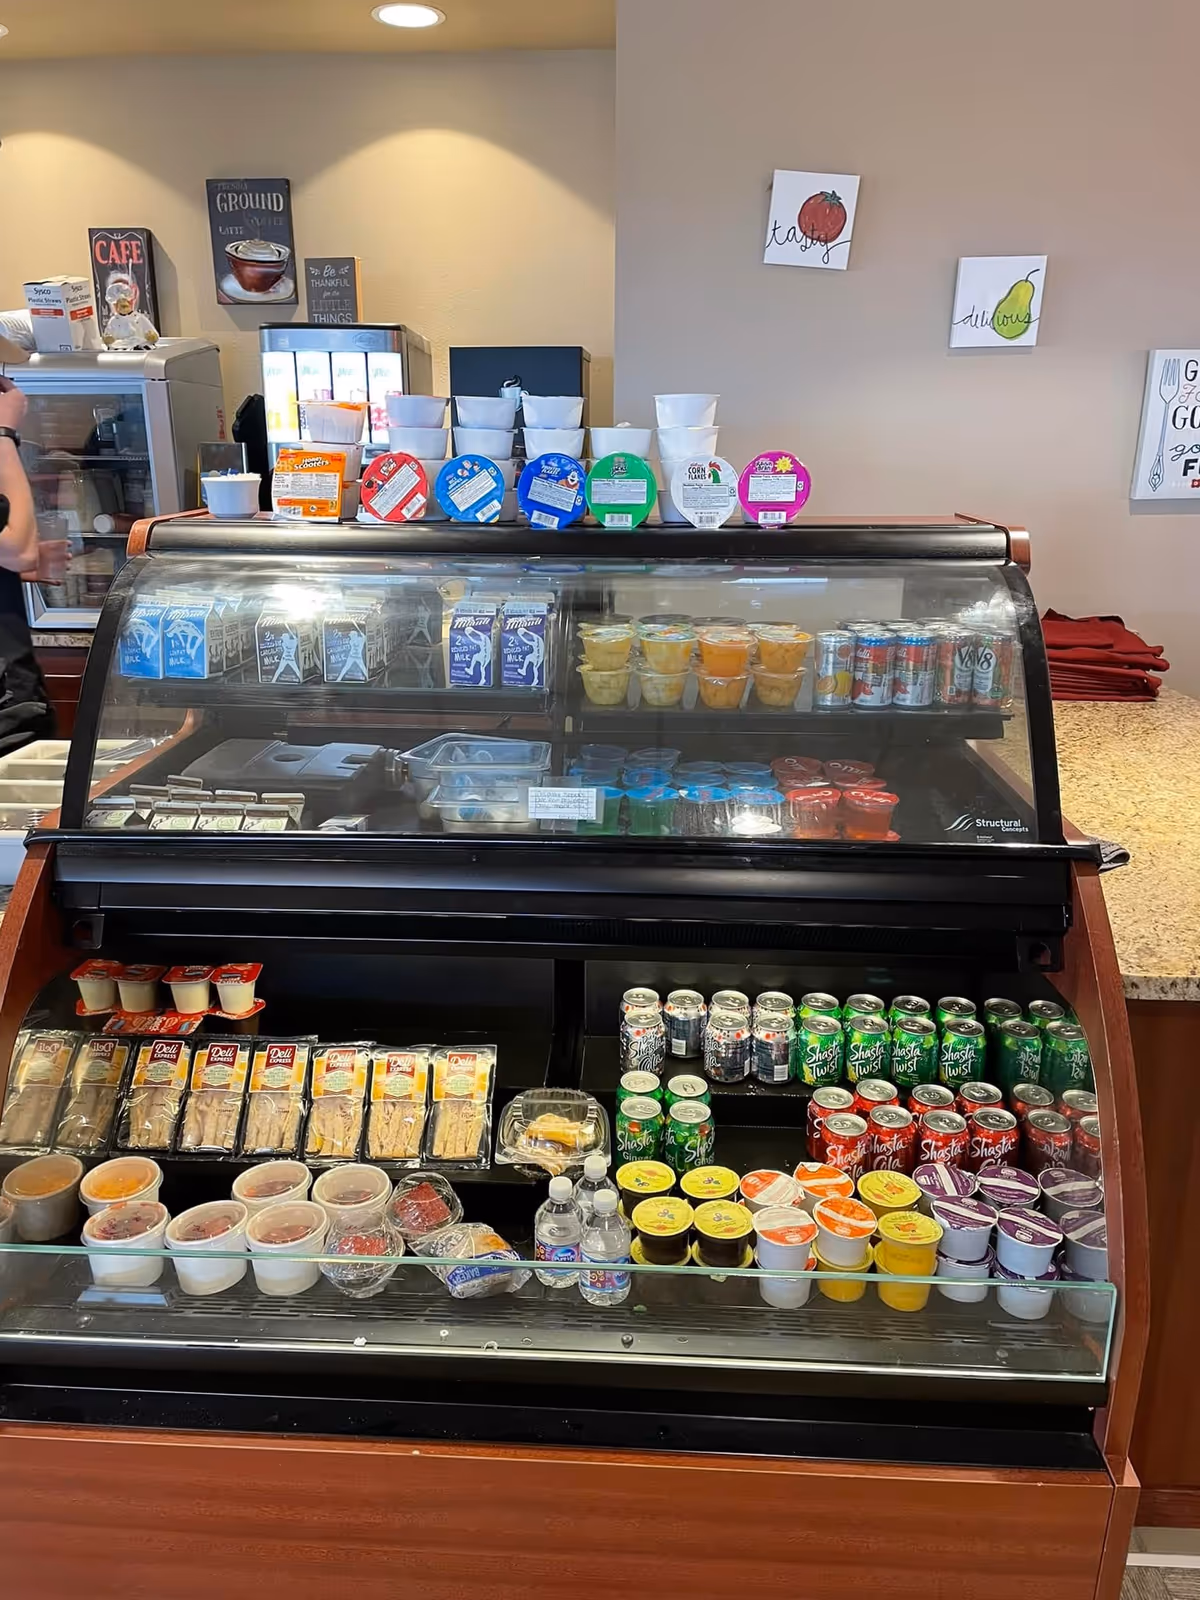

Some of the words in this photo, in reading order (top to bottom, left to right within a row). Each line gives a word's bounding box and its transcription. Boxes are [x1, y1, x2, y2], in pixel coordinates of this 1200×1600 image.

[216, 192, 284, 213] GROUND
[765, 220, 851, 265] tasty
[323, 265, 336, 277] Be
[311, 279, 350, 287] THANKFUL
[33, 287, 51, 295] Sysco
[312, 300, 352, 311] LITTLE
[312, 313, 352, 323] THINGS
[953, 305, 1040, 330] delicious
[688, 466, 706, 474] CORN
[264, 656, 280, 665] MILK
[455, 653, 471, 661] MILK
[507, 653, 525, 663] MILK
[976, 645, 993, 670] V8
[975, 819, 1021, 827] Structural
[155, 1043, 178, 1054] Deli
[211, 1046, 234, 1057] Deli
[269, 1048, 293, 1058] Deli
[806, 1041, 841, 1063] Shasta
[850, 1041, 885, 1061] Shasta
[941, 1043, 976, 1063] Shasta
[329, 1052, 353, 1063] Deli
[389, 1055, 413, 1067] Deli
[450, 1056, 474, 1066] Deli
[808, 1055, 839, 1079] Twist
[852, 1056, 883, 1078] Twist
[892, 1058, 919, 1075] Twist
[942, 1059, 974, 1078] Twist
[617, 1129, 655, 1151] Shasta
[825, 1140, 869, 1166] Shasta
[920, 1139, 965, 1161] Shasta
[971, 1136, 1016, 1159] Shasta
